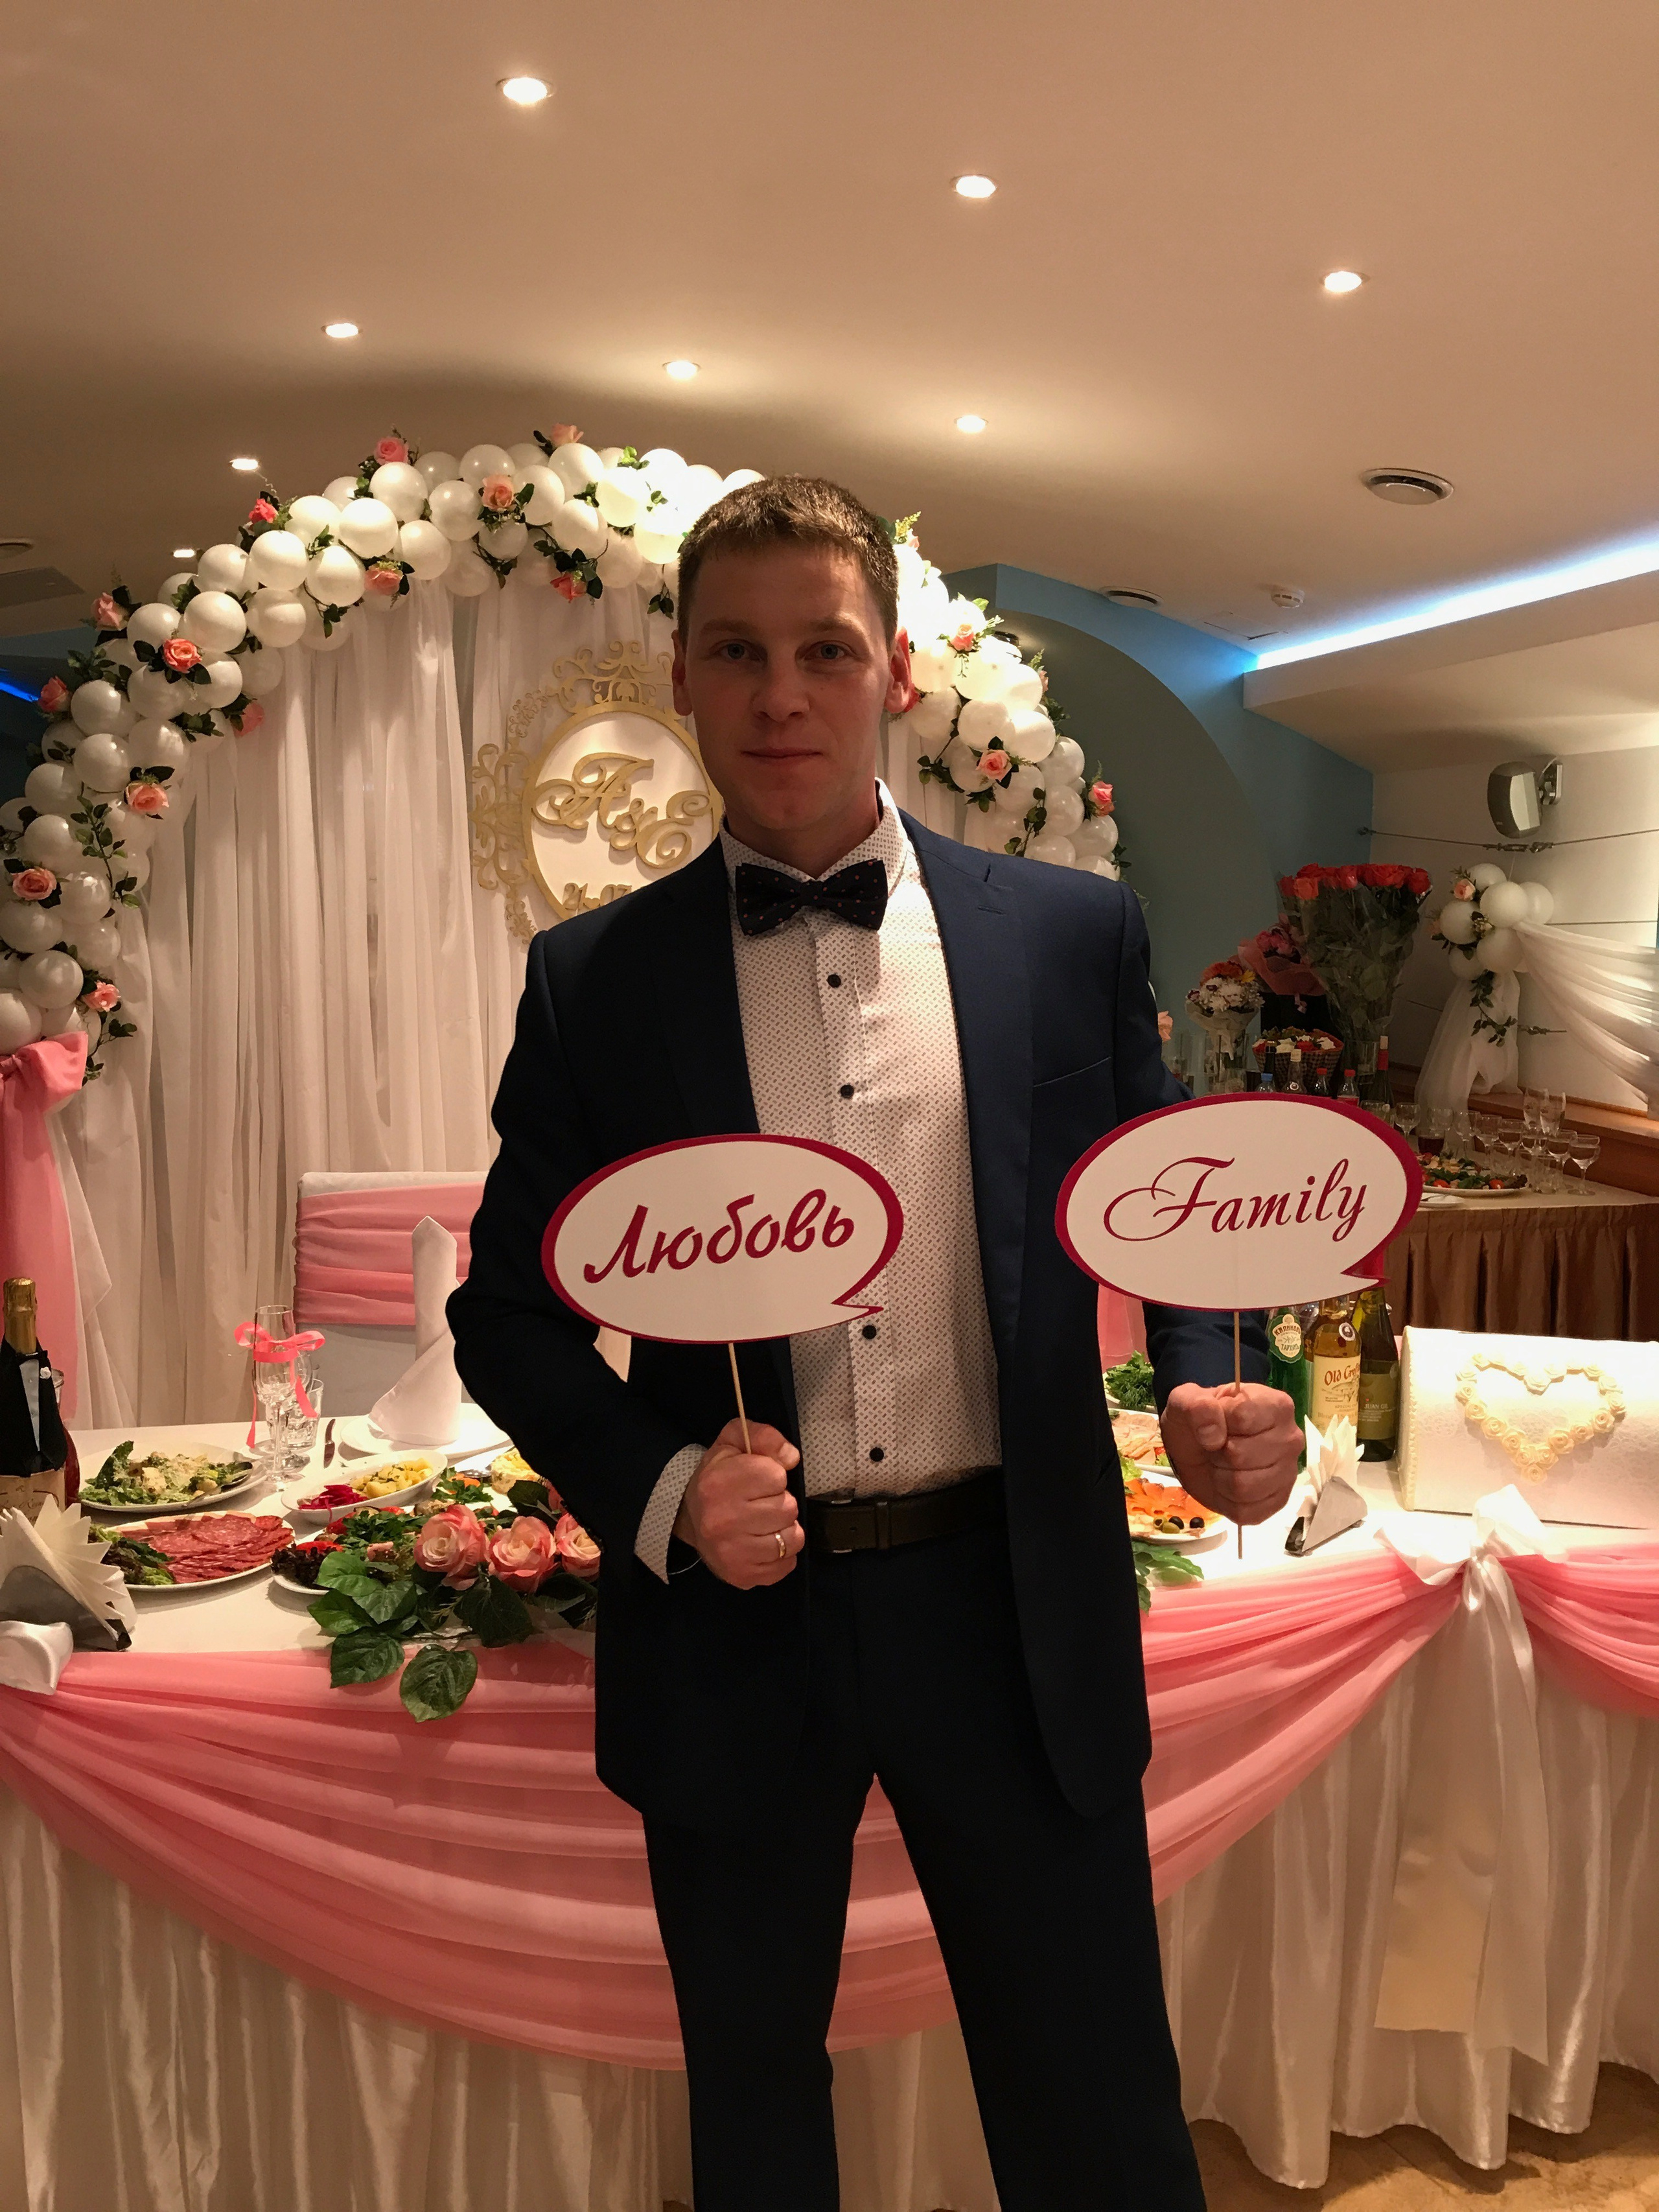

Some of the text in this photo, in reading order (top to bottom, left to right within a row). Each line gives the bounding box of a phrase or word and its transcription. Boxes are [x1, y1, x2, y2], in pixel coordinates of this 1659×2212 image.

[583, 1189, 855, 1283] Любовь
[1103, 1156, 1367, 1242] Family
[1324, 1369, 1341, 1386] Old
